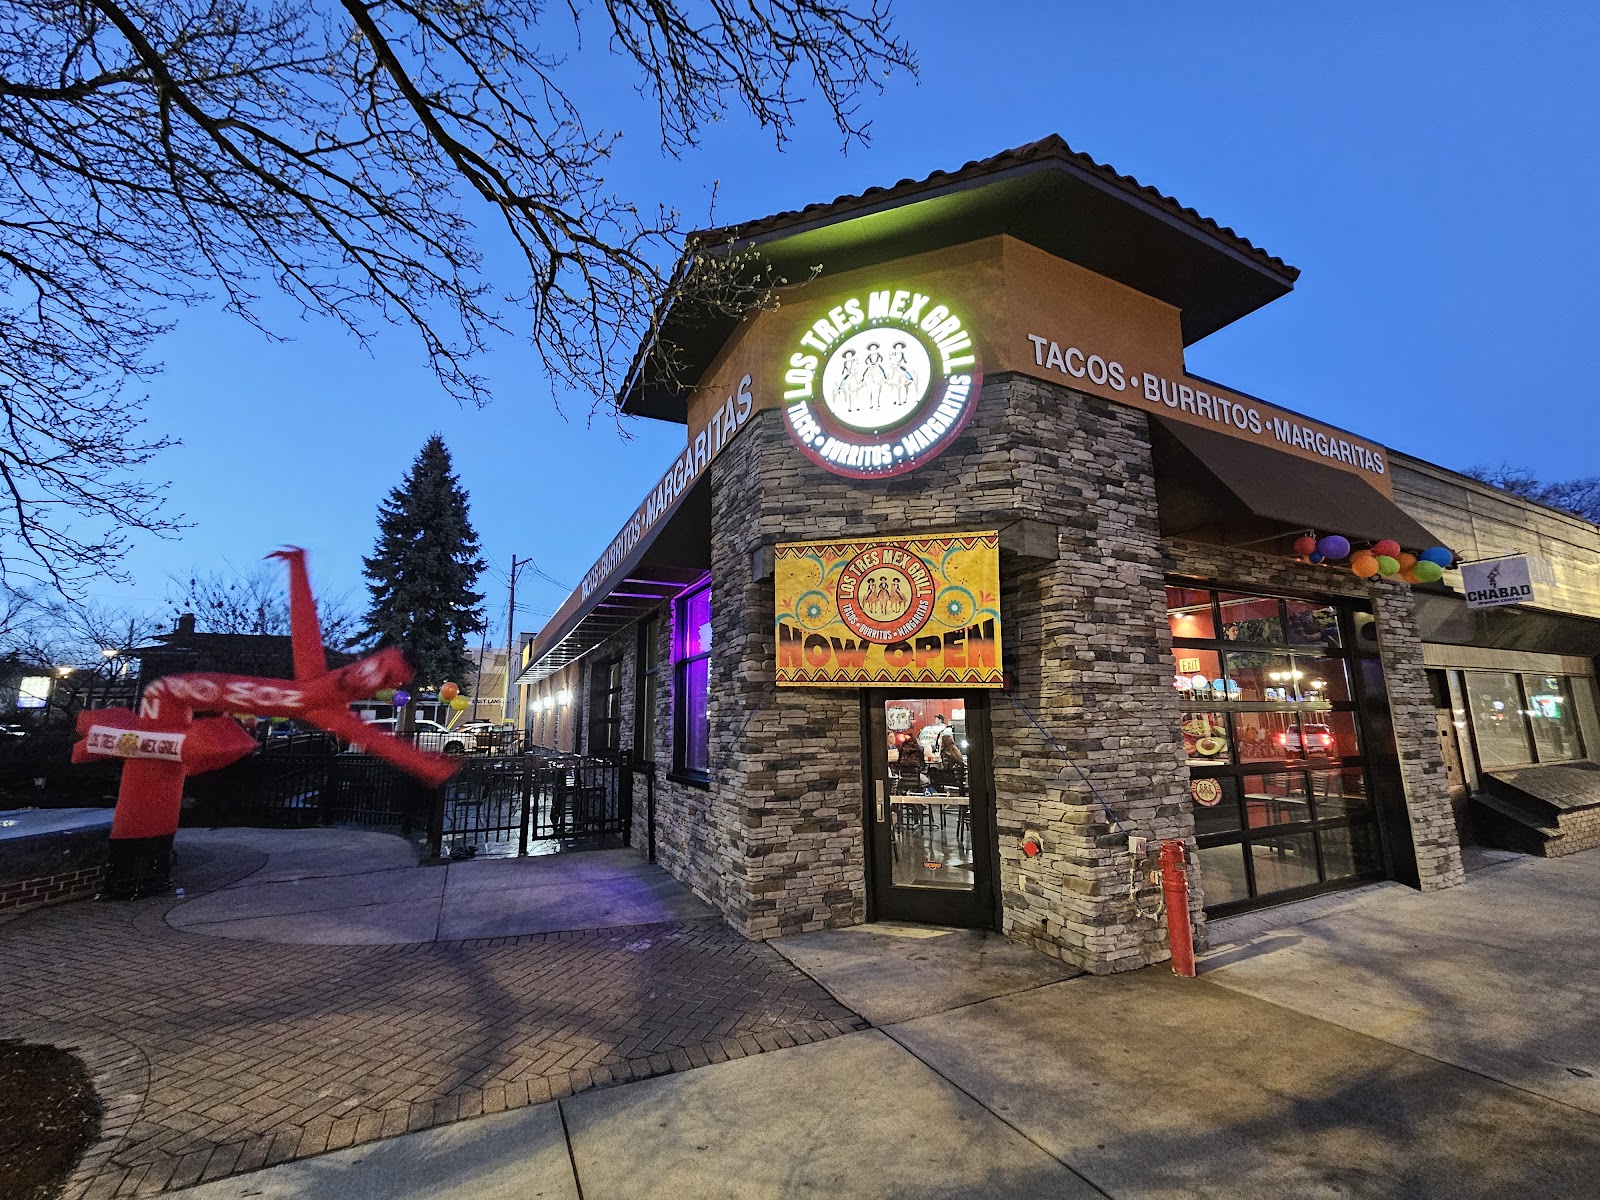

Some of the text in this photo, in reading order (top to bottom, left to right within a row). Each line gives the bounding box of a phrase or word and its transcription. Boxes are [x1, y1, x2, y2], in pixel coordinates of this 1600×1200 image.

[784, 290, 975, 400] LOS TRES MEX GRILL
[787, 374, 972, 465] TACOS BURRITOS MARGARITAS
[1028, 333, 1384, 474] TACOS BURRITOS MARGARITAS
[582, 374, 752, 602] TACOS BURRITOS MARGARITAS
[840, 549, 932, 599] LOS TRES MEX GRILL
[1467, 585, 1531, 602] CHABAD
[778, 618, 996, 668] NOW OPEN
[843, 600, 929, 639] TACOS BURRITOS MARGARITAS
[1182, 660, 1198, 670] EXIT
